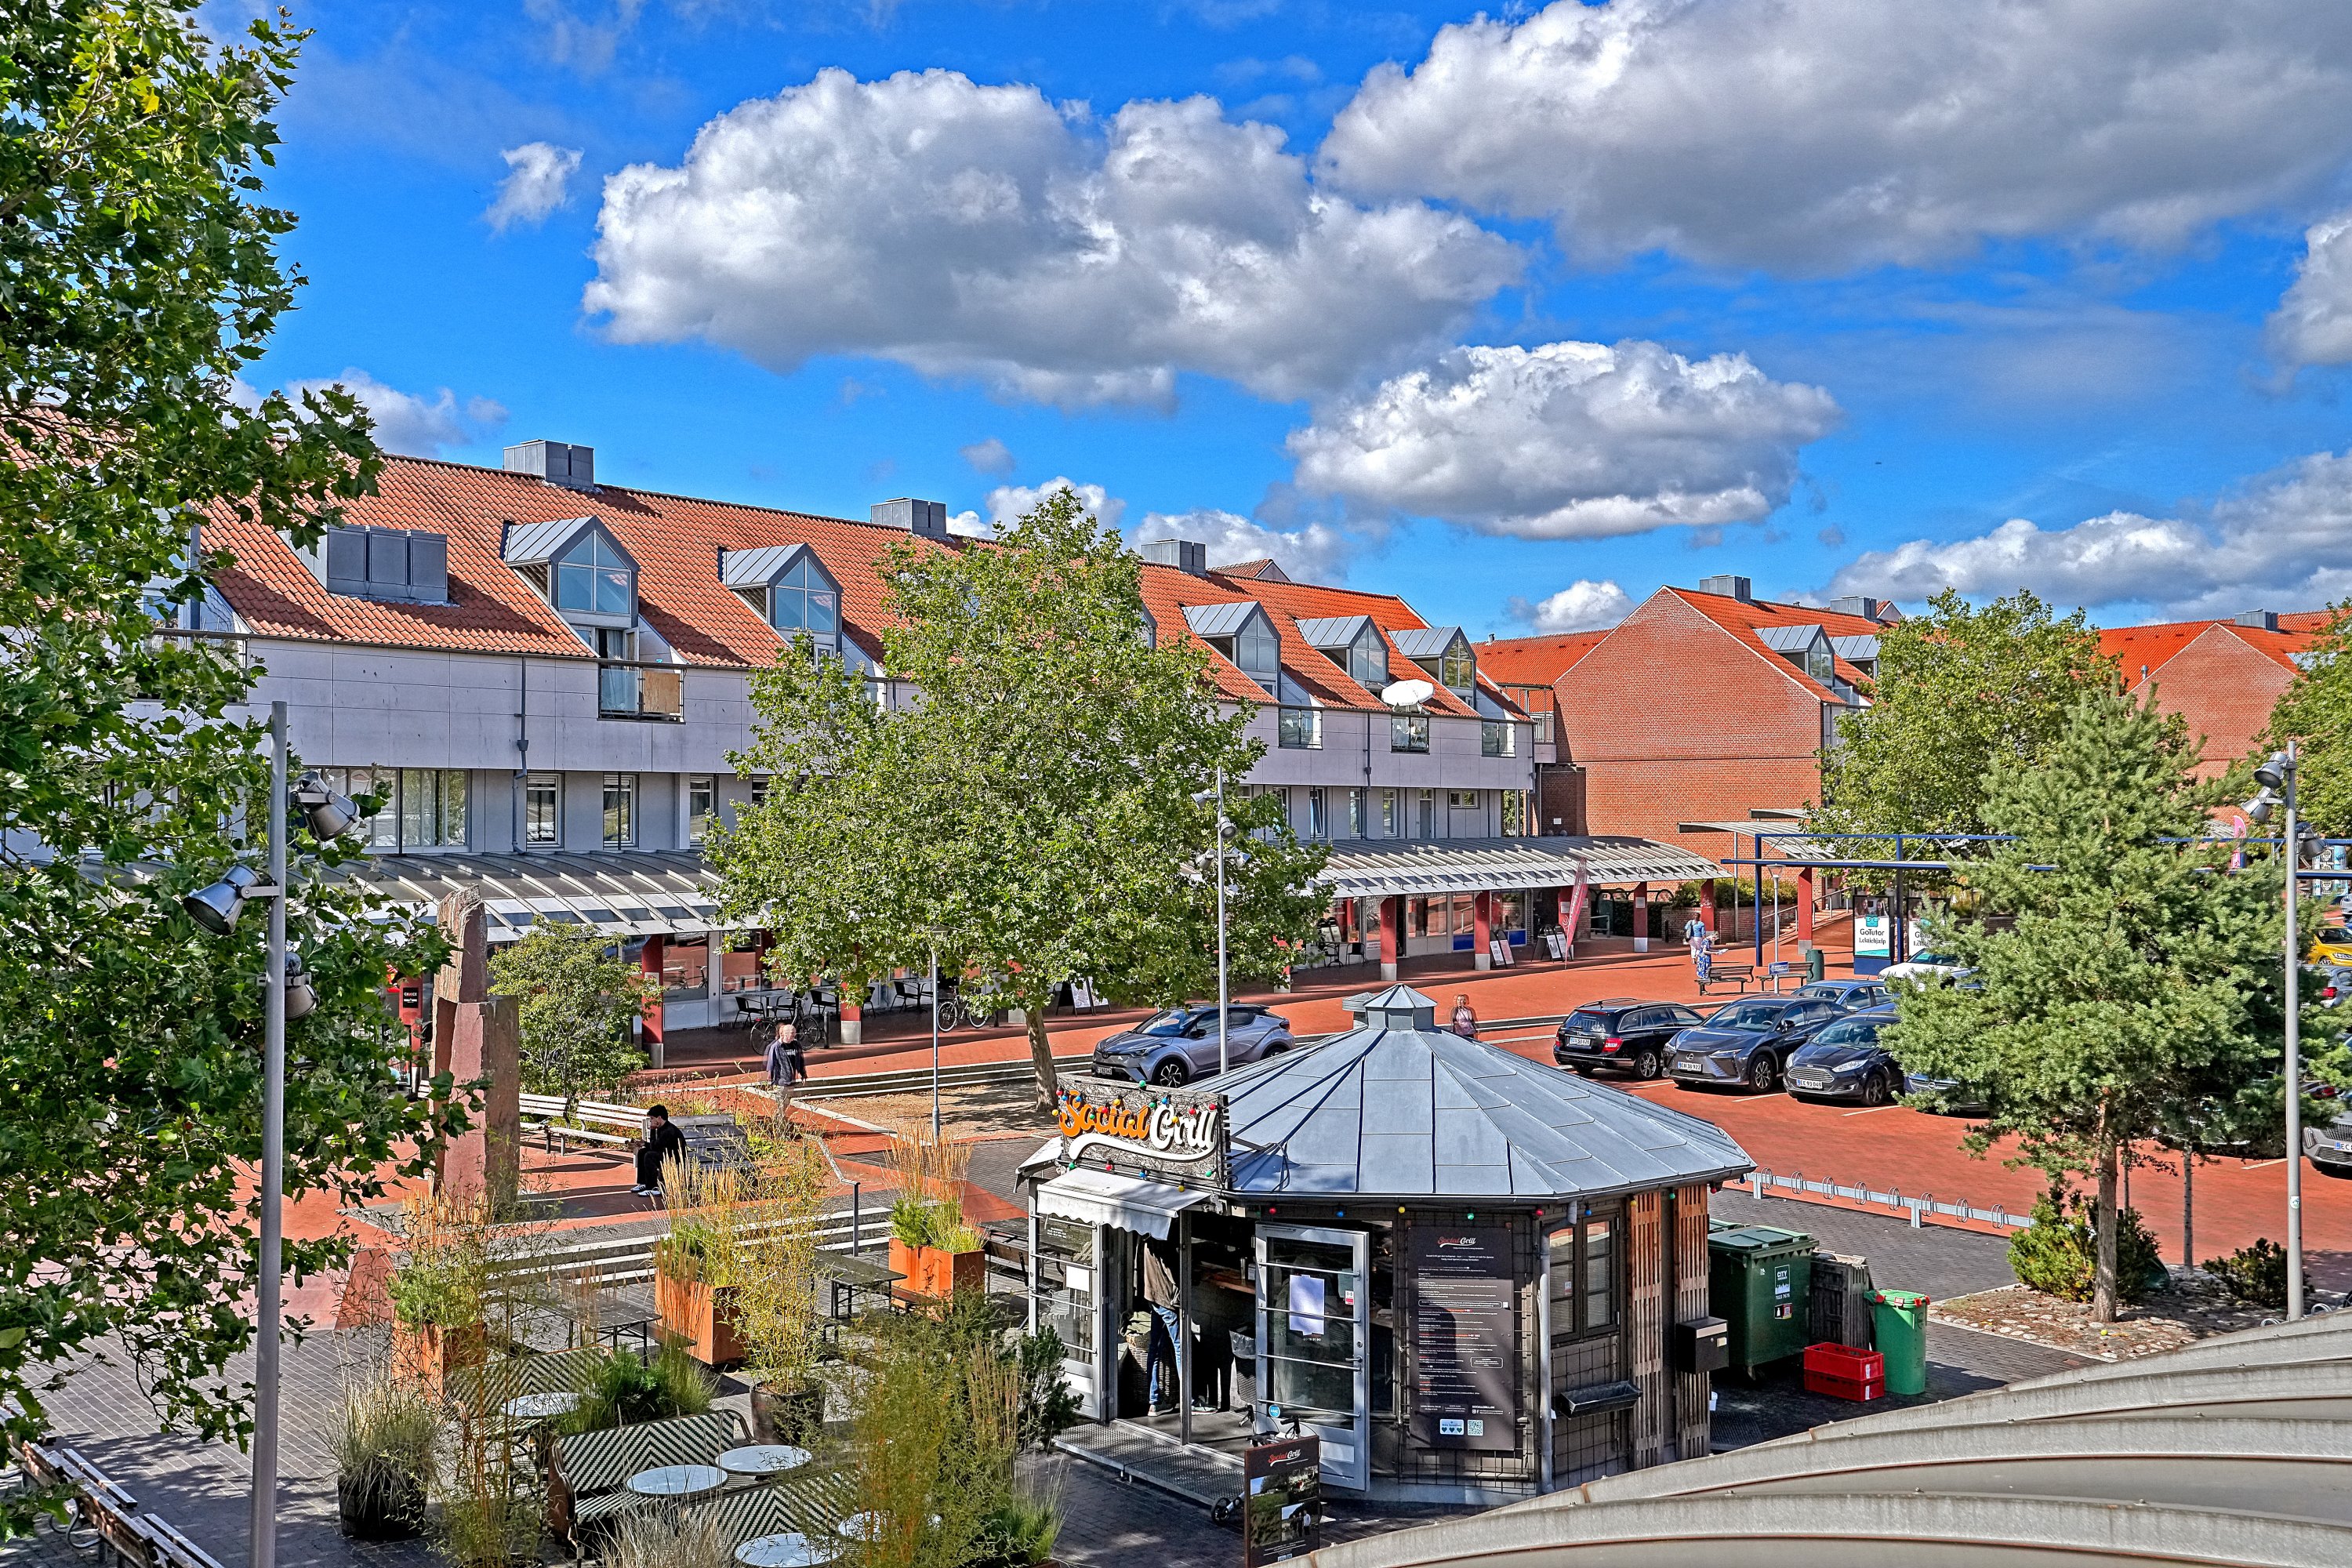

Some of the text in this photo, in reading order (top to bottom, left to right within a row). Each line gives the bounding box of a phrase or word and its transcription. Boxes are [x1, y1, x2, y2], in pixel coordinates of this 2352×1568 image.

[1059, 1090, 1218, 1151] Social Grill
[1438, 1236, 1476, 1245] Social Grill
[1268, 1452, 1287, 1464] Social
[1287, 1448, 1301, 1459] Grill
